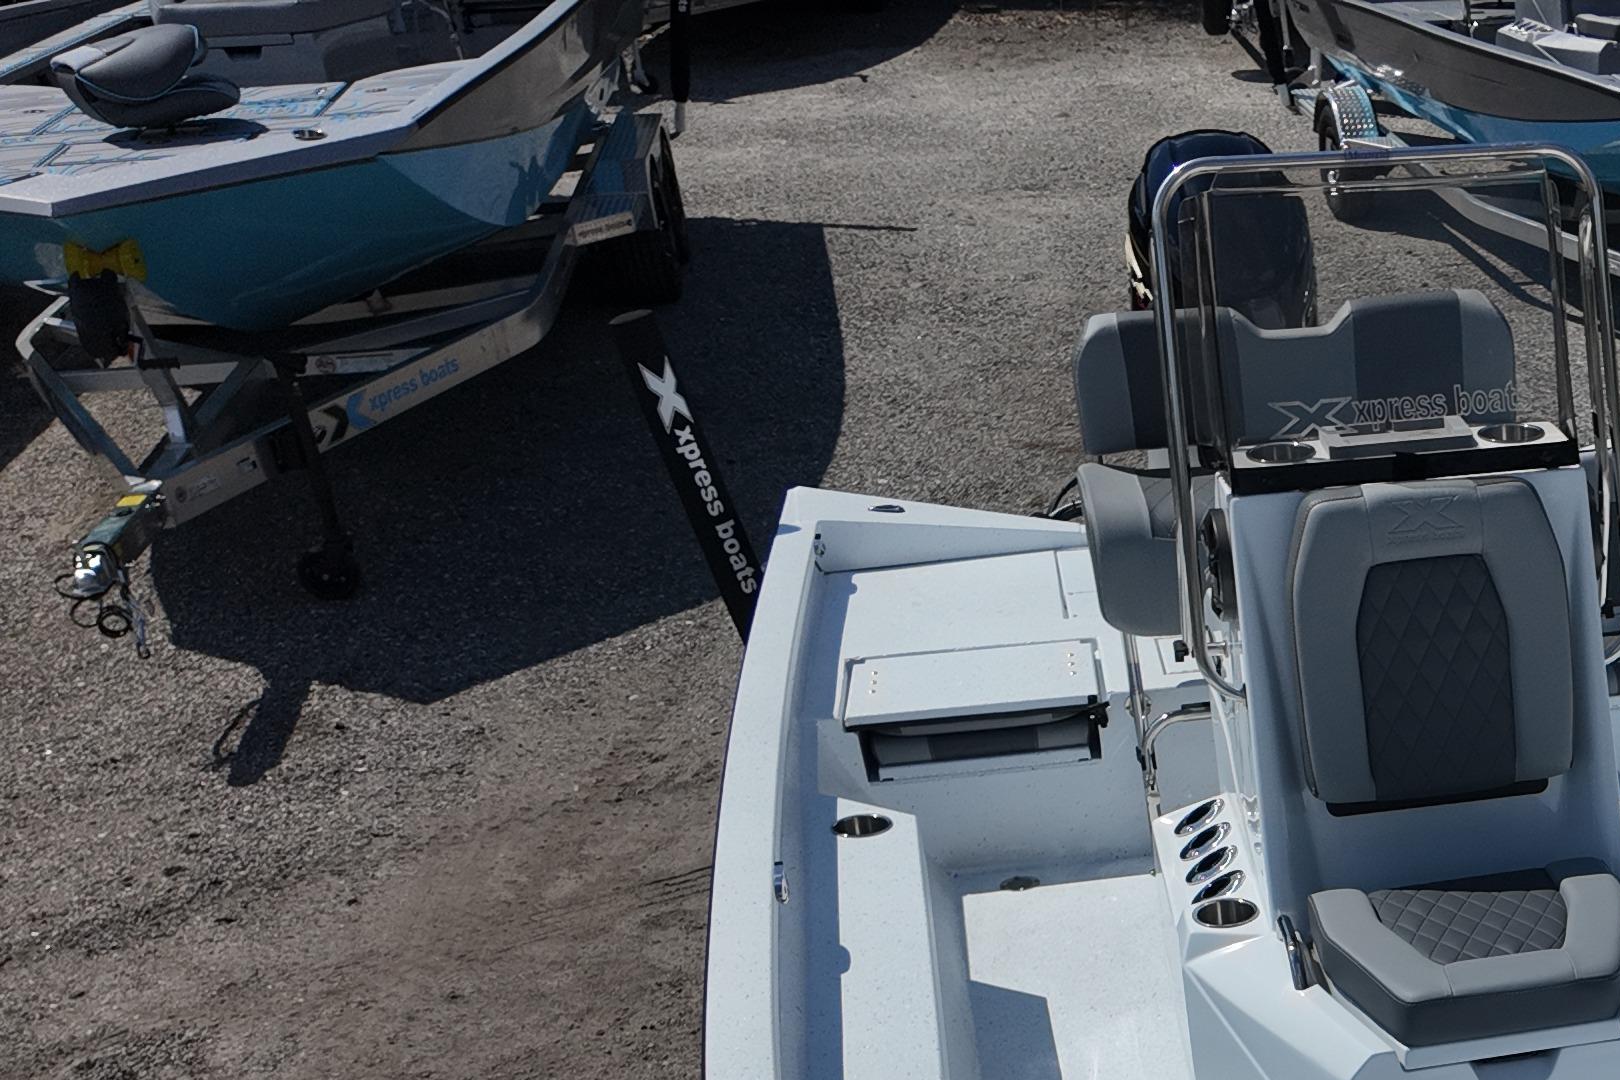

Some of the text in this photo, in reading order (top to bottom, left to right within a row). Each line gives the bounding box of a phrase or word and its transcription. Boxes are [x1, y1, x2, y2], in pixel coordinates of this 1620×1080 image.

[367, 378, 418, 412] xpress
[418, 358, 460, 387] boats
[1351, 393, 1447, 431] xpress
[674, 424, 725, 517] xpress
[715, 519, 757, 594] boats
